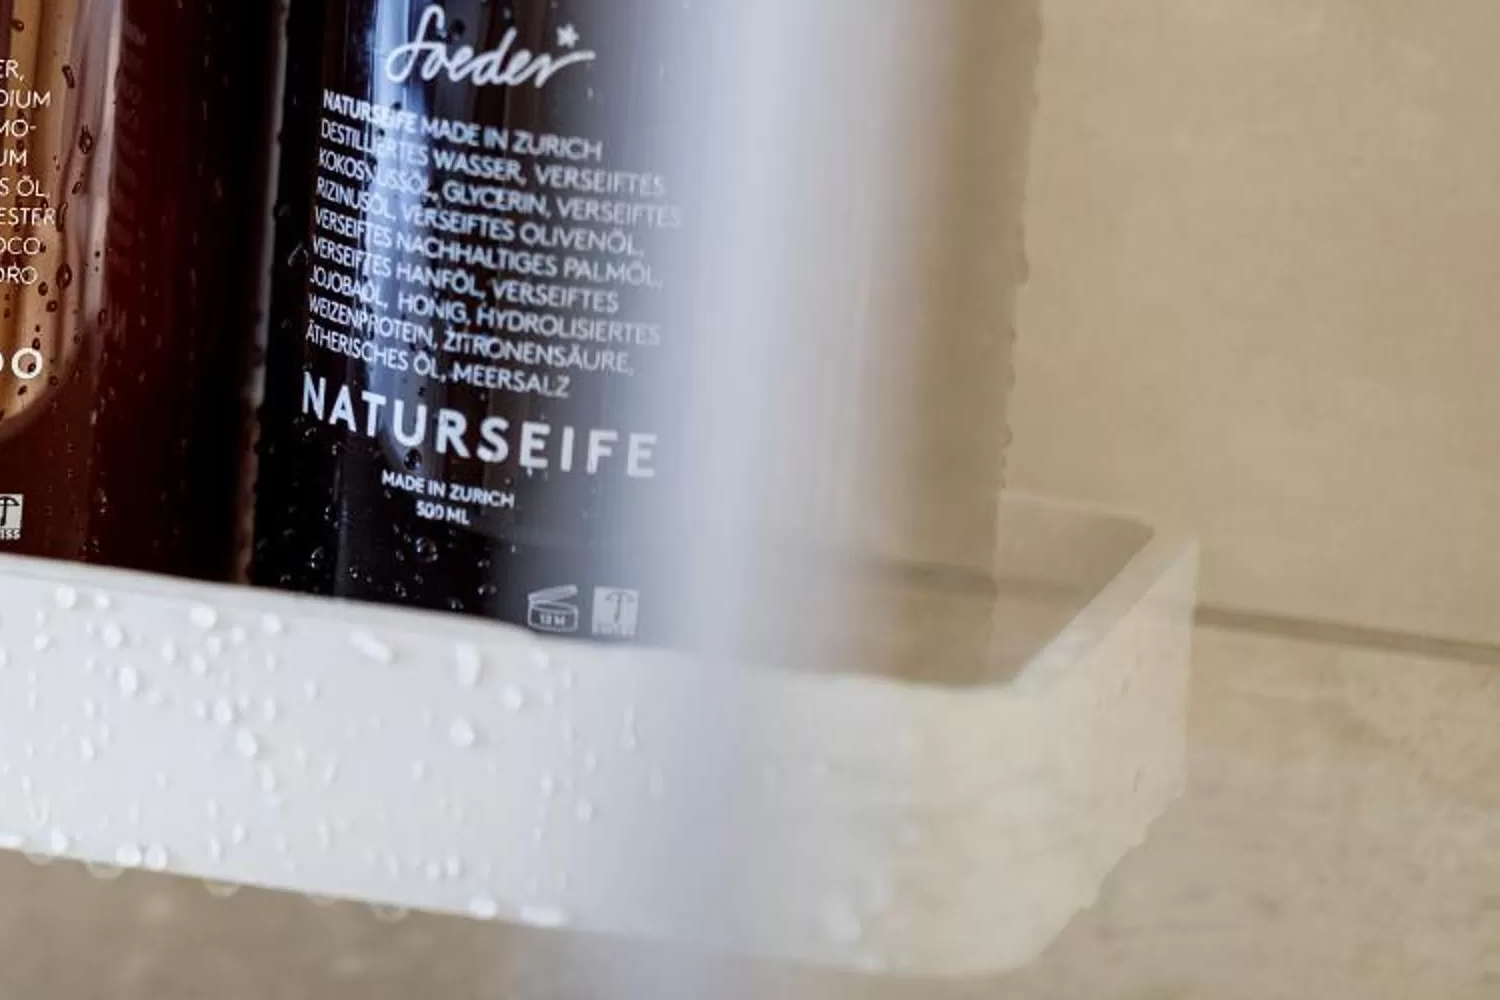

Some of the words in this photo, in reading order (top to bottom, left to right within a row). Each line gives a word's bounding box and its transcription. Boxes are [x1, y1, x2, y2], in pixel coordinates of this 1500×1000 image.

[323, 89, 419, 133] NATURSEIFE
[420, 116, 481, 147] MADE
[483, 126, 509, 150] IN
[512, 129, 603, 161] ZURICH
[432, 149, 527, 186] WASSER,
[534, 163, 665, 197] VERSEIFTES
[443, 180, 551, 219] GLYCERIN,
[556, 197, 681, 229] VERSEIFTES
[313, 205, 392, 248] VERSEIFTES
[395, 231, 558, 278] NACHHALTIGES
[401, 201, 516, 242] VERSEIFTES
[519, 221, 645, 257] OLIVENÖL,
[311, 235, 391, 277] VERSEIFTES
[395, 263, 486, 298] HANFÖL,
[491, 279, 619, 313] VERSEIFTES
[308, 293, 438, 349] WEIZENPROTEIN,
[444, 330, 635, 376] ZITRONENSÄURE,
[397, 291, 471, 325] HONIG,
[476, 306, 661, 345] HYDROLISIERTES
[305, 319, 409, 371] ÄTHERISCHES
[452, 361, 571, 399] MEERSALZ
[301, 371, 659, 478] NATURSEIFE
[381, 469, 425, 494] MADE
[427, 479, 447, 498] IN
[450, 484, 515, 509] ZURICH
[415, 501, 445, 521] 500
[446, 506, 471, 526] ML
